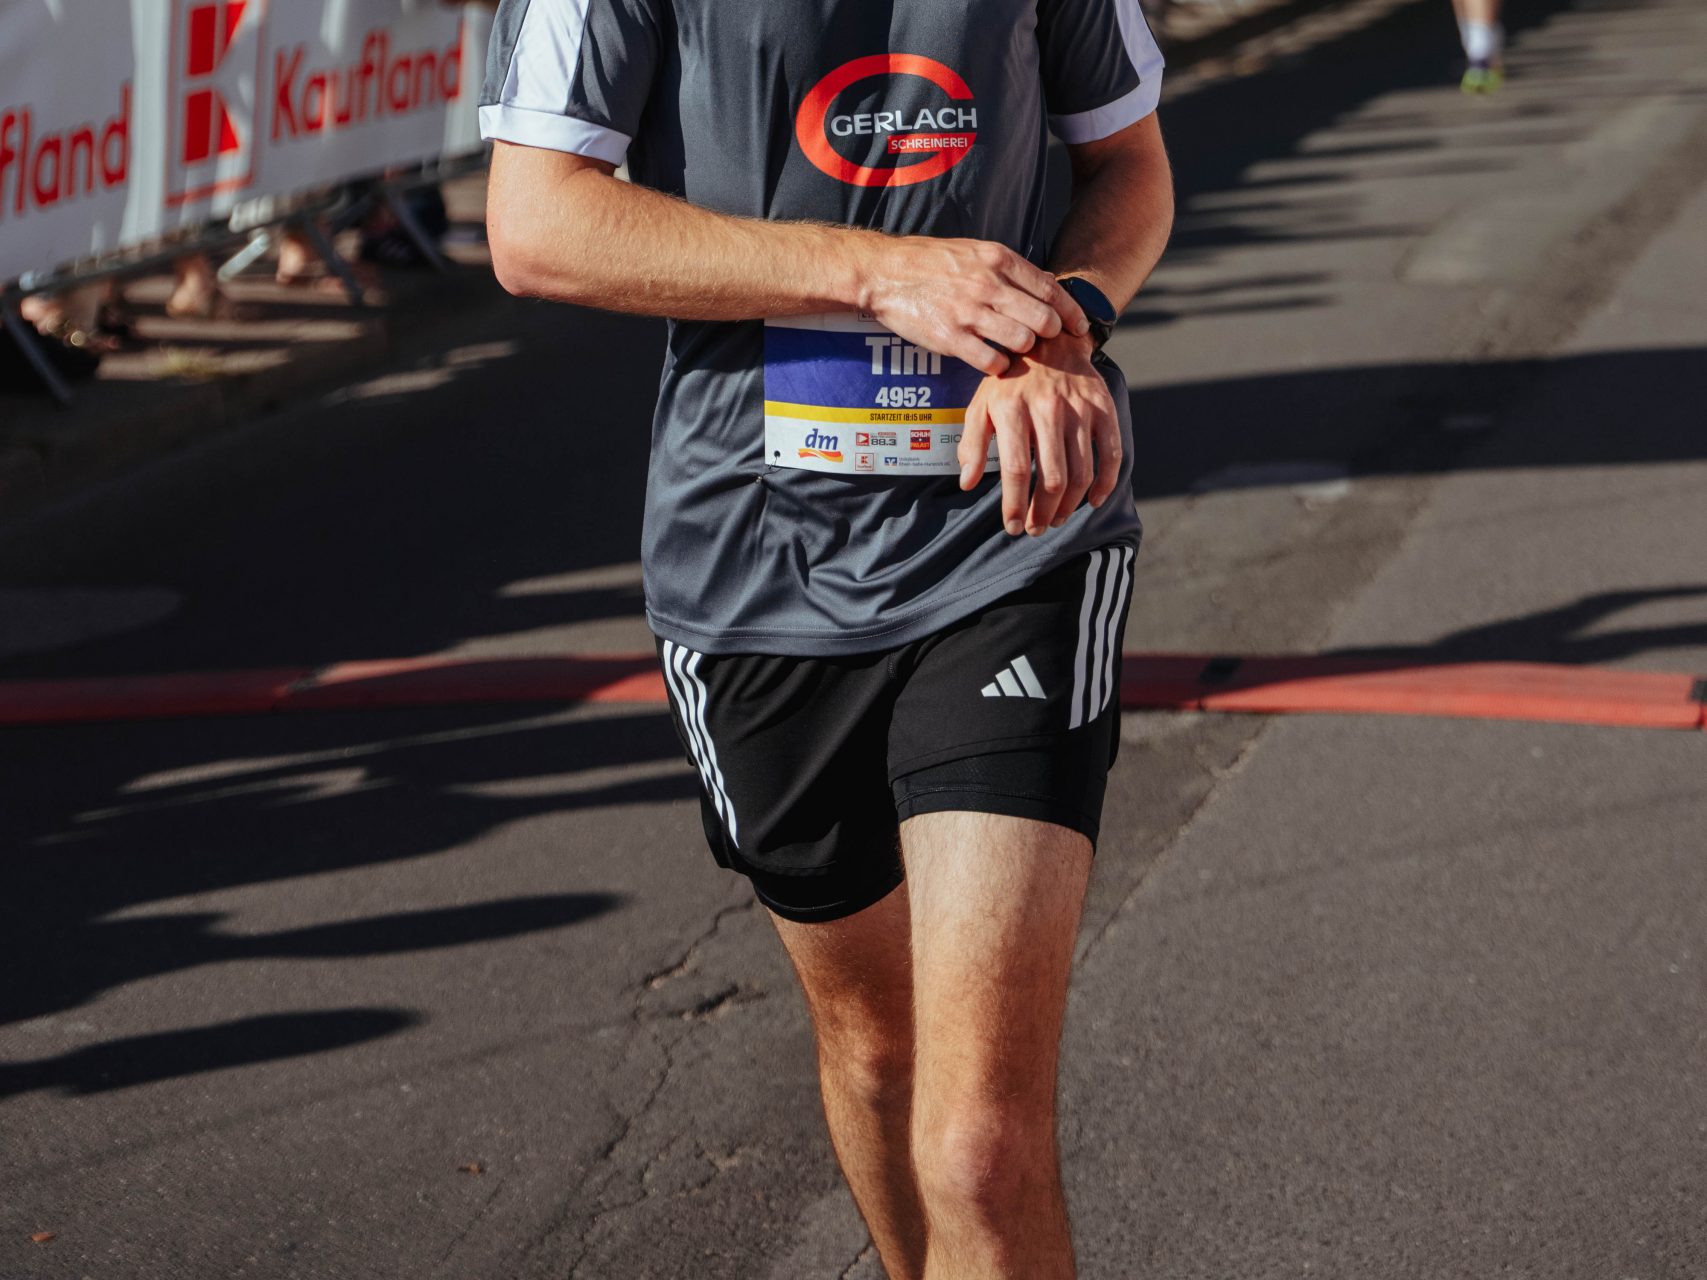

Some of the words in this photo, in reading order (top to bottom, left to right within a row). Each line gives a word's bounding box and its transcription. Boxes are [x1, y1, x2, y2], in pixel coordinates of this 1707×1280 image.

[270, 18, 466, 142] Kaufland
[830, 107, 978, 137] GERLACH
[891, 137, 968, 150] SCHREINEREI
[865, 336, 941, 375] Tim
[875, 386, 931, 407] 4952
[870, 413, 902, 421] STARTZEIT
[918, 413, 933, 421] UHR
[804, 428, 839, 450] dm
[871, 438, 897, 446] 88.3
